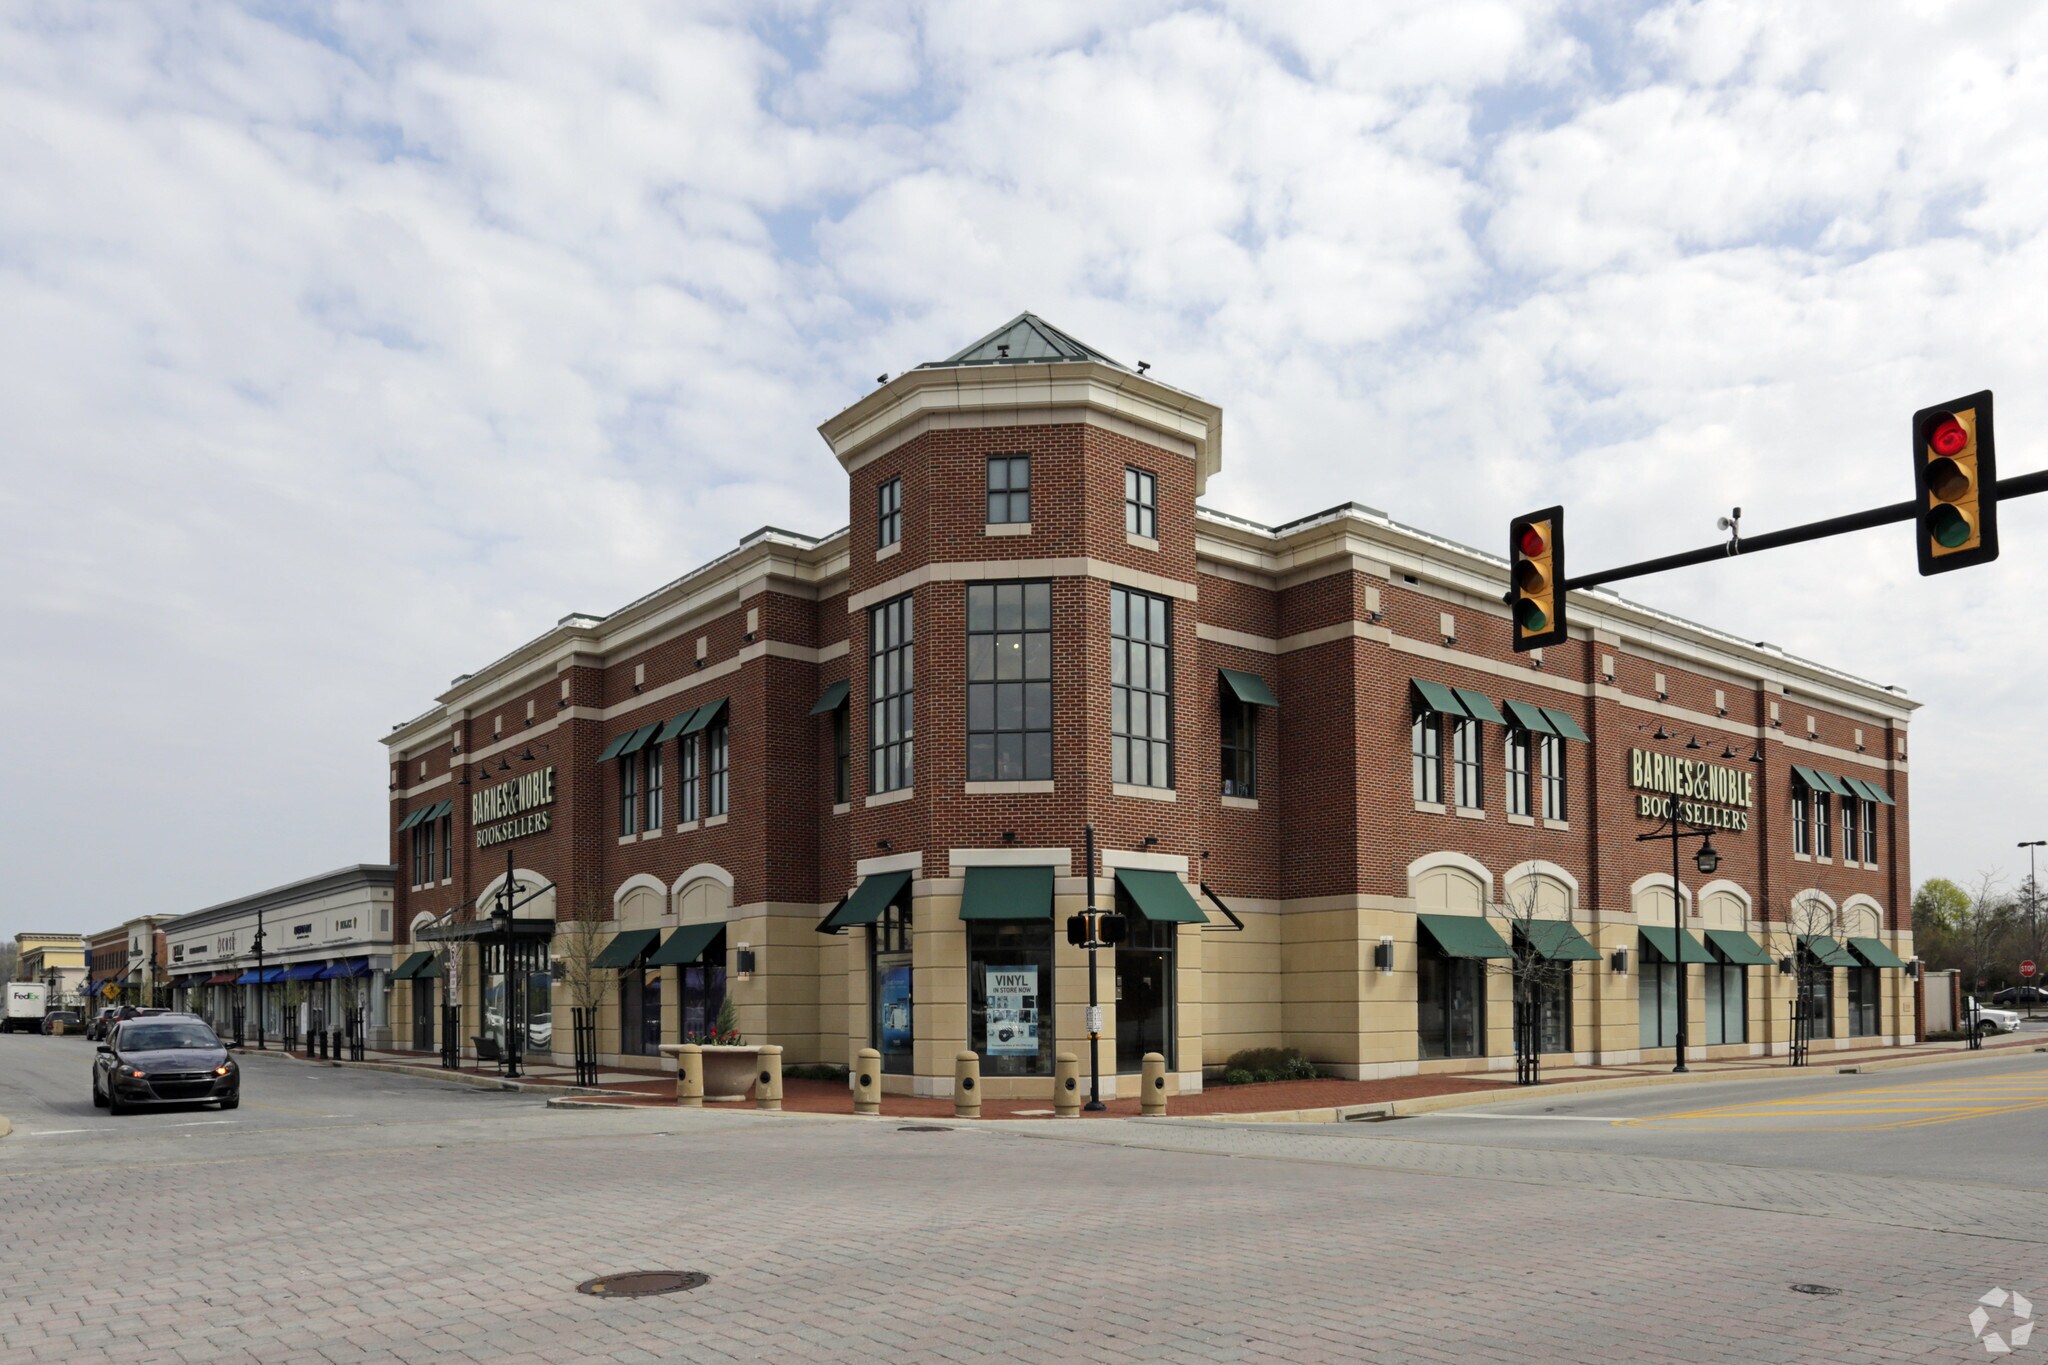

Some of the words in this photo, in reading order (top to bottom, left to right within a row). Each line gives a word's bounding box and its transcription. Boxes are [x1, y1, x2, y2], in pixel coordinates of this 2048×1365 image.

[476, 811, 548, 848] BOOKSELLERS
[995, 975, 1029, 986] VINYL
[14, 992, 39, 1000] FedEx
